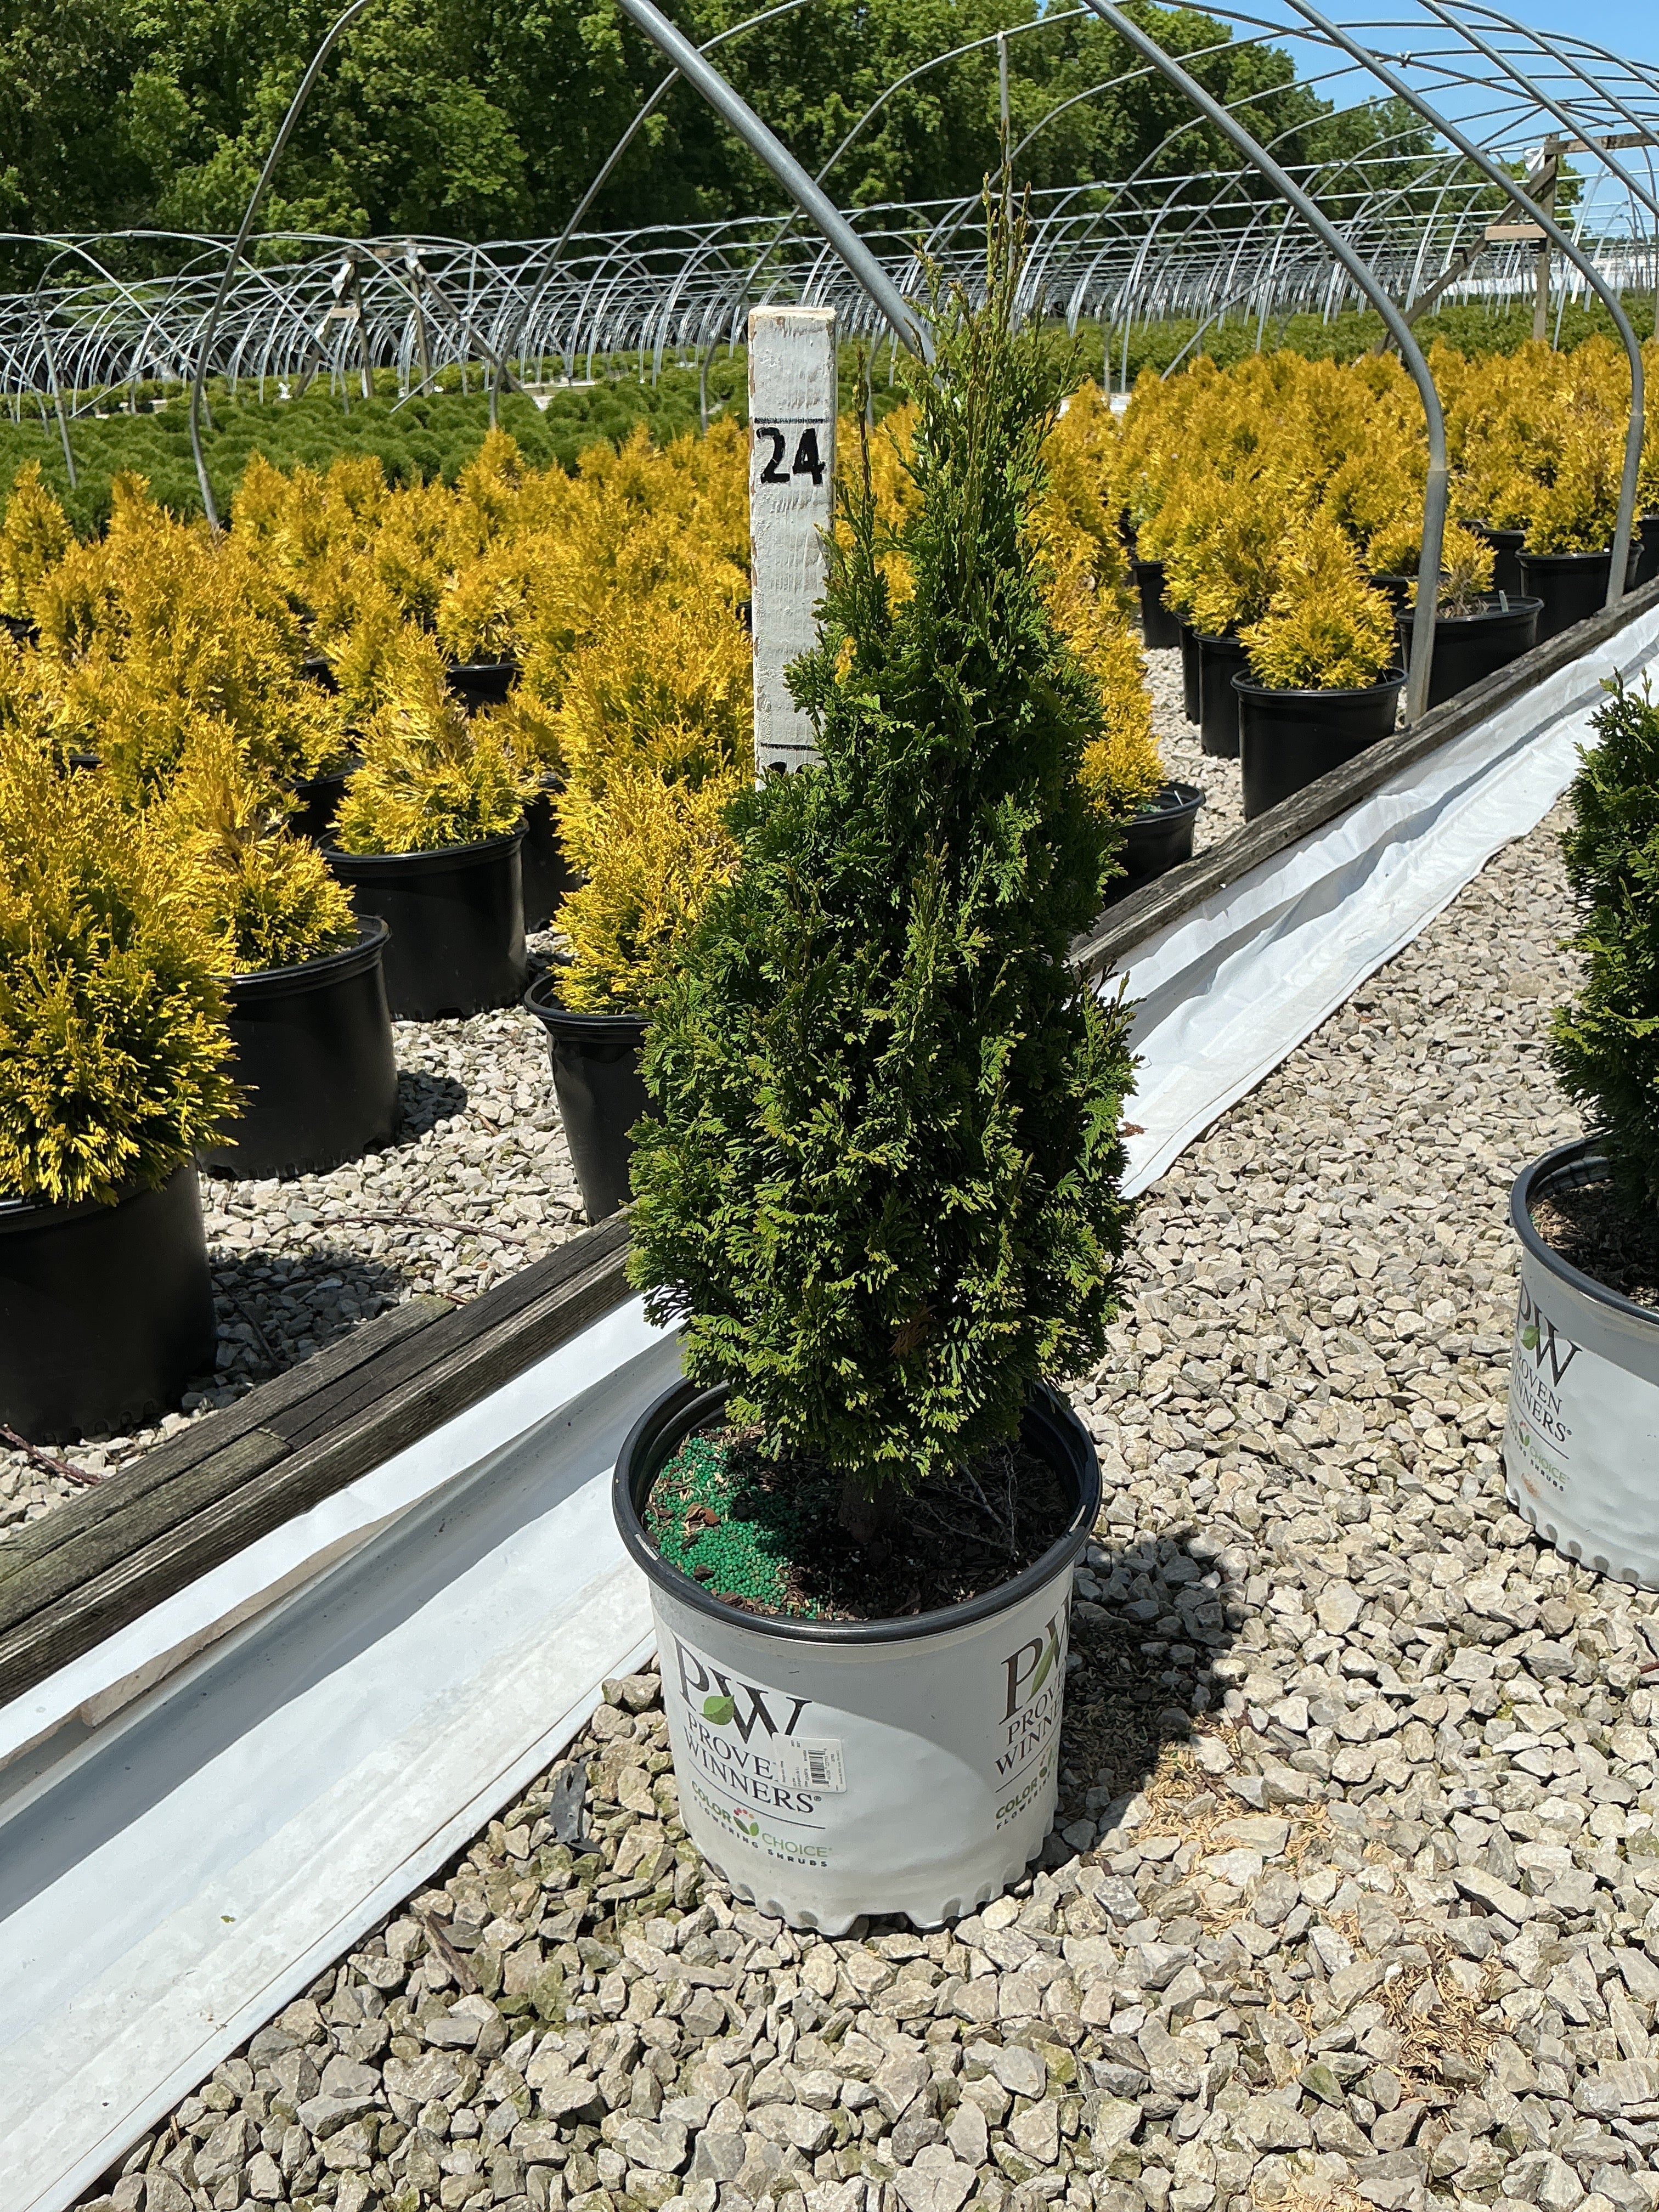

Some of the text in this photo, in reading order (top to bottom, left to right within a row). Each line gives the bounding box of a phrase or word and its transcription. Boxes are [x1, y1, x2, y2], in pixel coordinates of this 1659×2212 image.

[755, 427, 826, 485] 24
[670, 1630, 812, 1745] PW
[686, 1709, 778, 1782] PROVE
[692, 1780, 731, 1824] COLOR
[996, 1777, 1037, 1819] COLOR
[693, 1795, 828, 1867] FLOWERING SHRUBS
